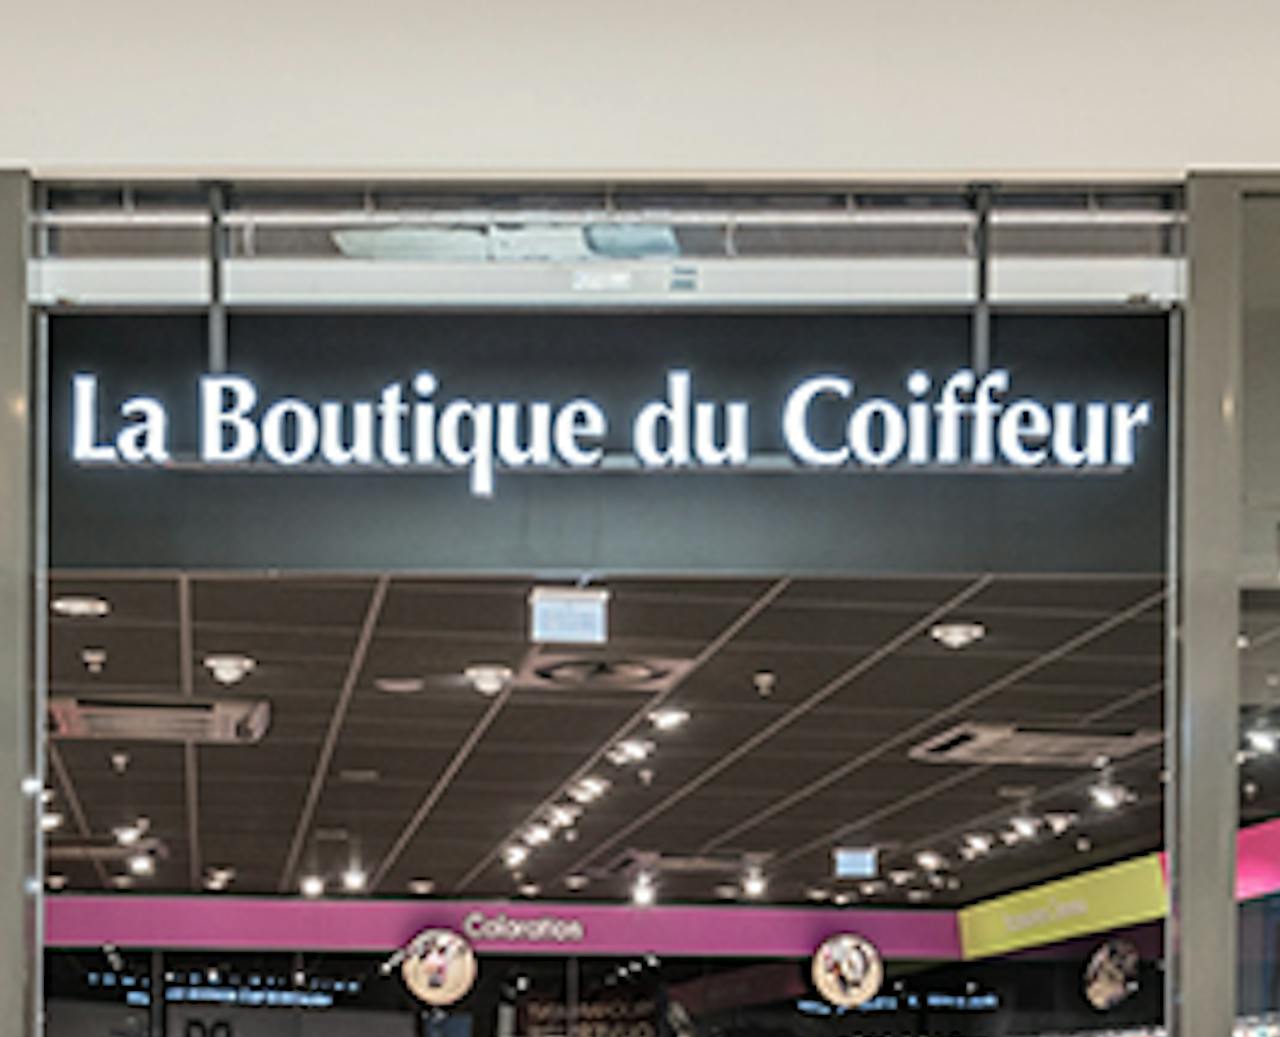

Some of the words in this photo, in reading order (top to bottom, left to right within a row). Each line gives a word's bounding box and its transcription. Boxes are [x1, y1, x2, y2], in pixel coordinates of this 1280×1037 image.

[70, 372, 169, 463] La
[199, 371, 606, 496] Boutique
[633, 370, 748, 464] du
[782, 369, 1149, 465] Coiffeur
[463, 911, 585, 940] Coloration
